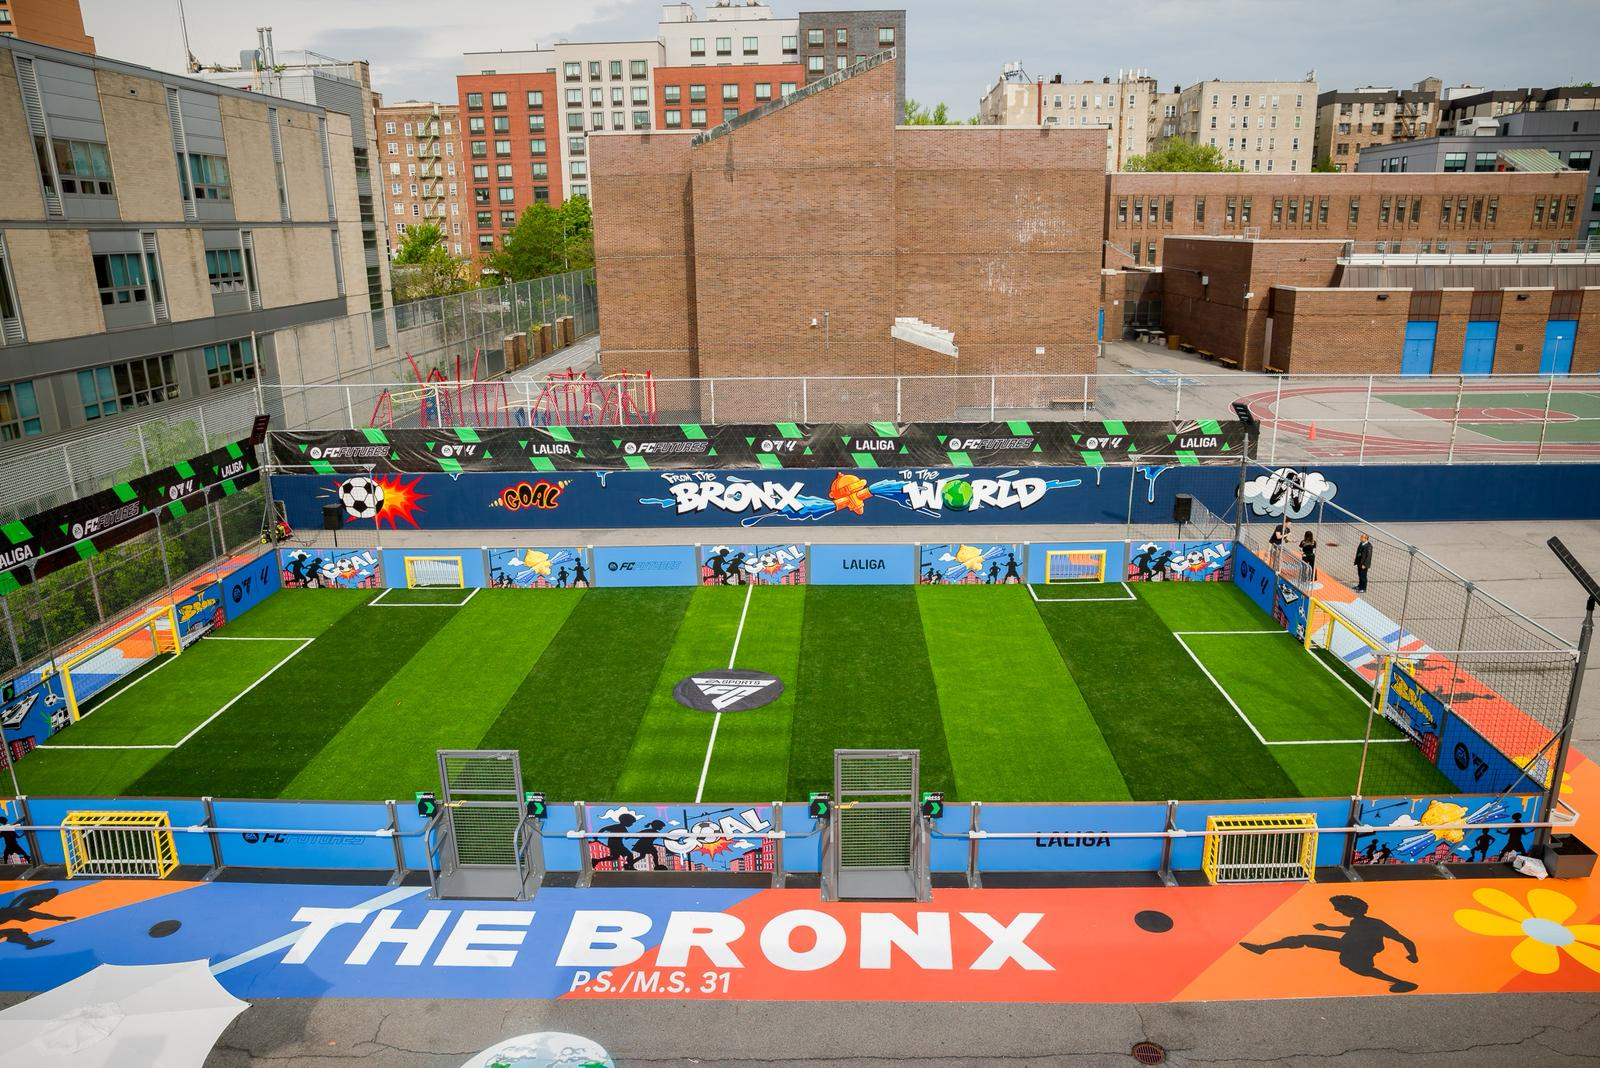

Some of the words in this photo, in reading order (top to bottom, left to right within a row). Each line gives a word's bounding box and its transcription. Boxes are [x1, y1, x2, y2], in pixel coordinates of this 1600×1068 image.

[532, 444, 571, 455] LALIGA
[855, 439, 895, 451] LALIGA
[1180, 437, 1217, 449] LALIGA
[221, 460, 244, 478] LALIGA
[504, 482, 560, 511] GOAL
[669, 481, 805, 514] BRONX
[842, 559, 886, 570] LALIGA
[1035, 831, 1111, 848] LALIGA
[280, 906, 537, 968] THE
[555, 909, 1057, 972] BRONX
[569, 971, 692, 993] P.S./M.S.
[699, 971, 731, 994] 31
